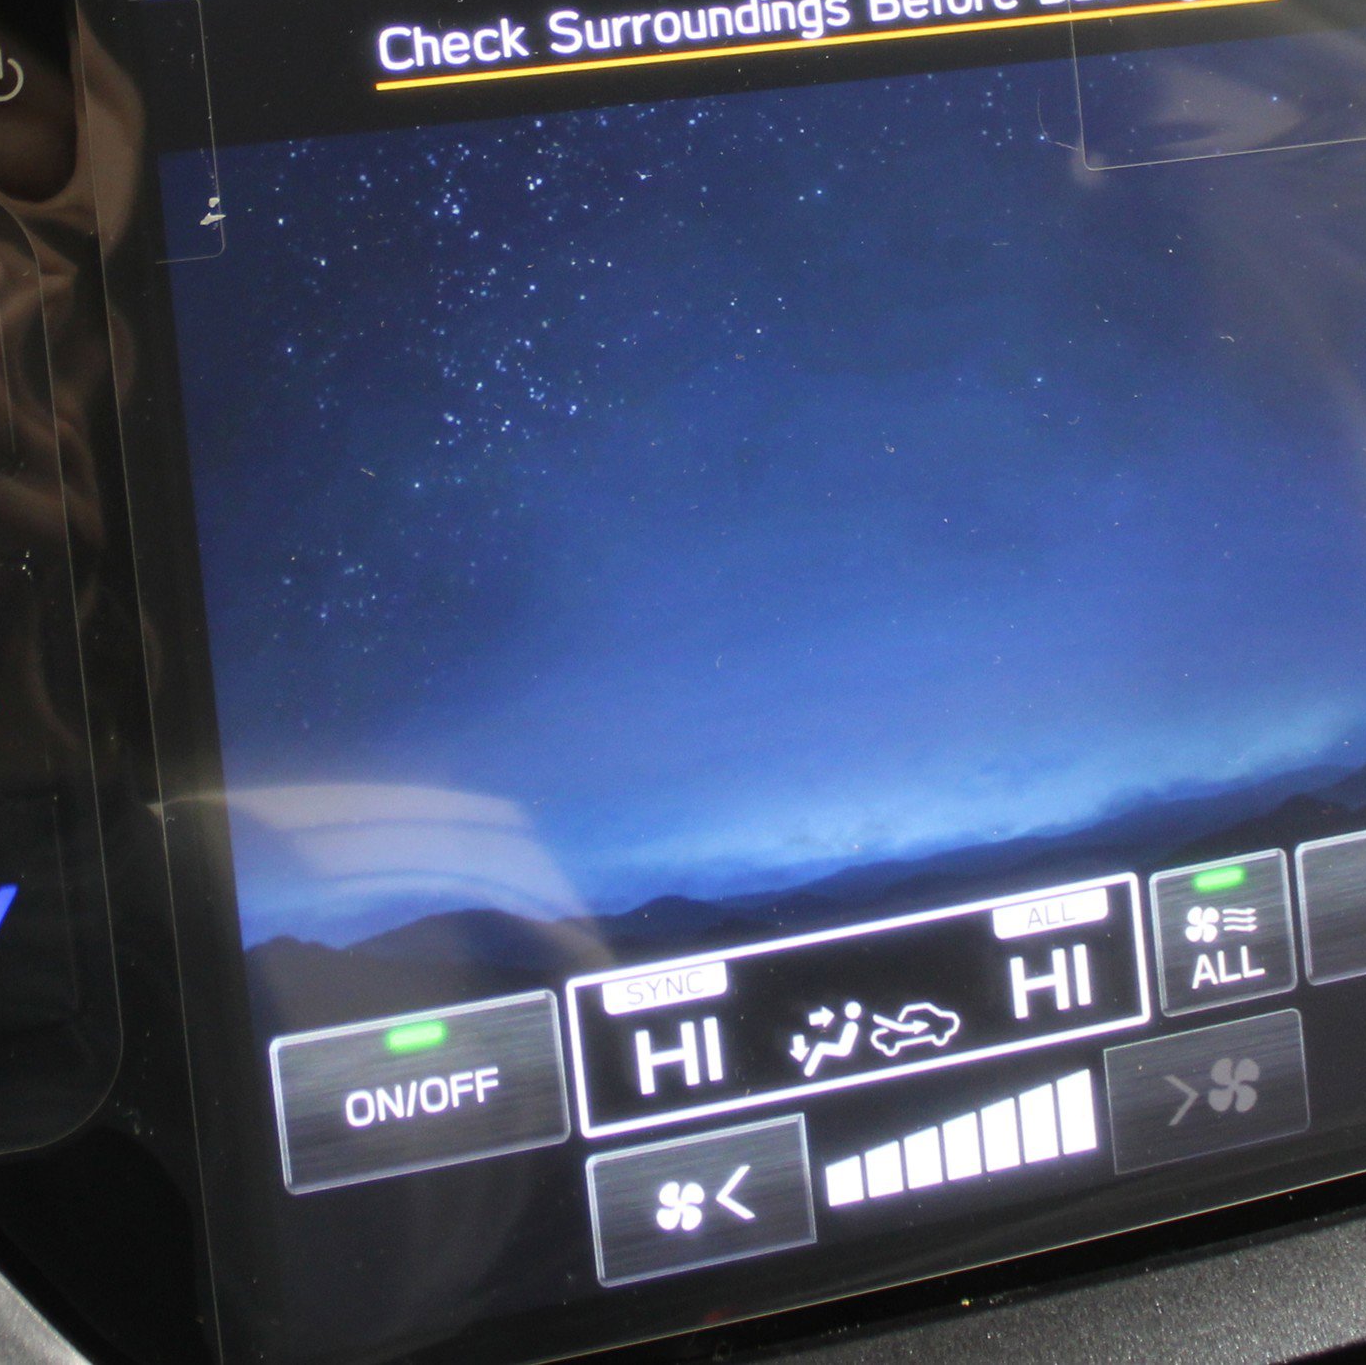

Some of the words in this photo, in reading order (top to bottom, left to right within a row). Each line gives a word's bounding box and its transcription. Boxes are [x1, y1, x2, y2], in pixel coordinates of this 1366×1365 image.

[378, 17, 528, 72] Check
[1027, 903, 1076, 929] ALL
[627, 967, 706, 1006] SYNC
[1010, 943, 1091, 1019] HI
[1191, 946, 1266, 990] ALL
[635, 1016, 723, 1095] HI
[345, 1067, 499, 1128] ON/OFF
